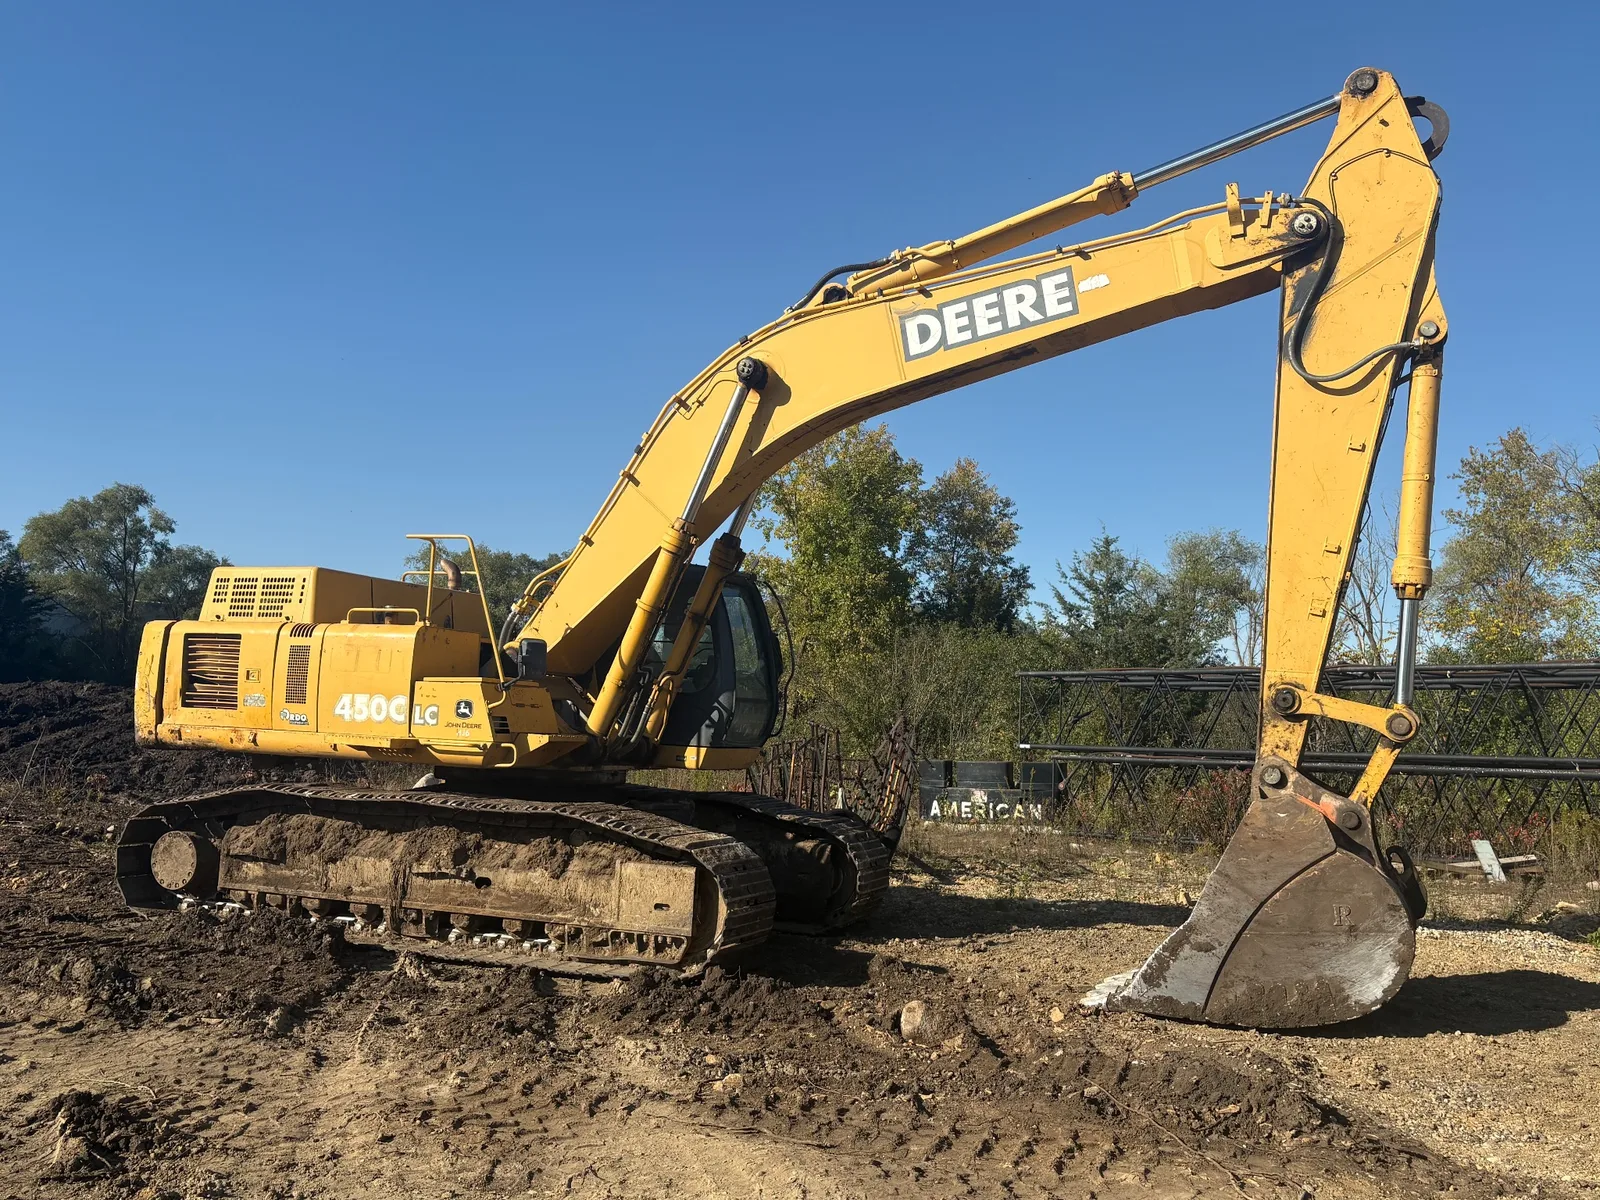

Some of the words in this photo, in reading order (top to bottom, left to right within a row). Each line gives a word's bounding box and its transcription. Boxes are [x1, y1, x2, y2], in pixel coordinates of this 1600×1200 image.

[904, 272, 1074, 357] DEERE
[334, 693, 407, 724] 450C
[413, 704, 439, 726] LC
[461, 722, 482, 730] DEERE
[930, 799, 1042, 820] AMERICAN
